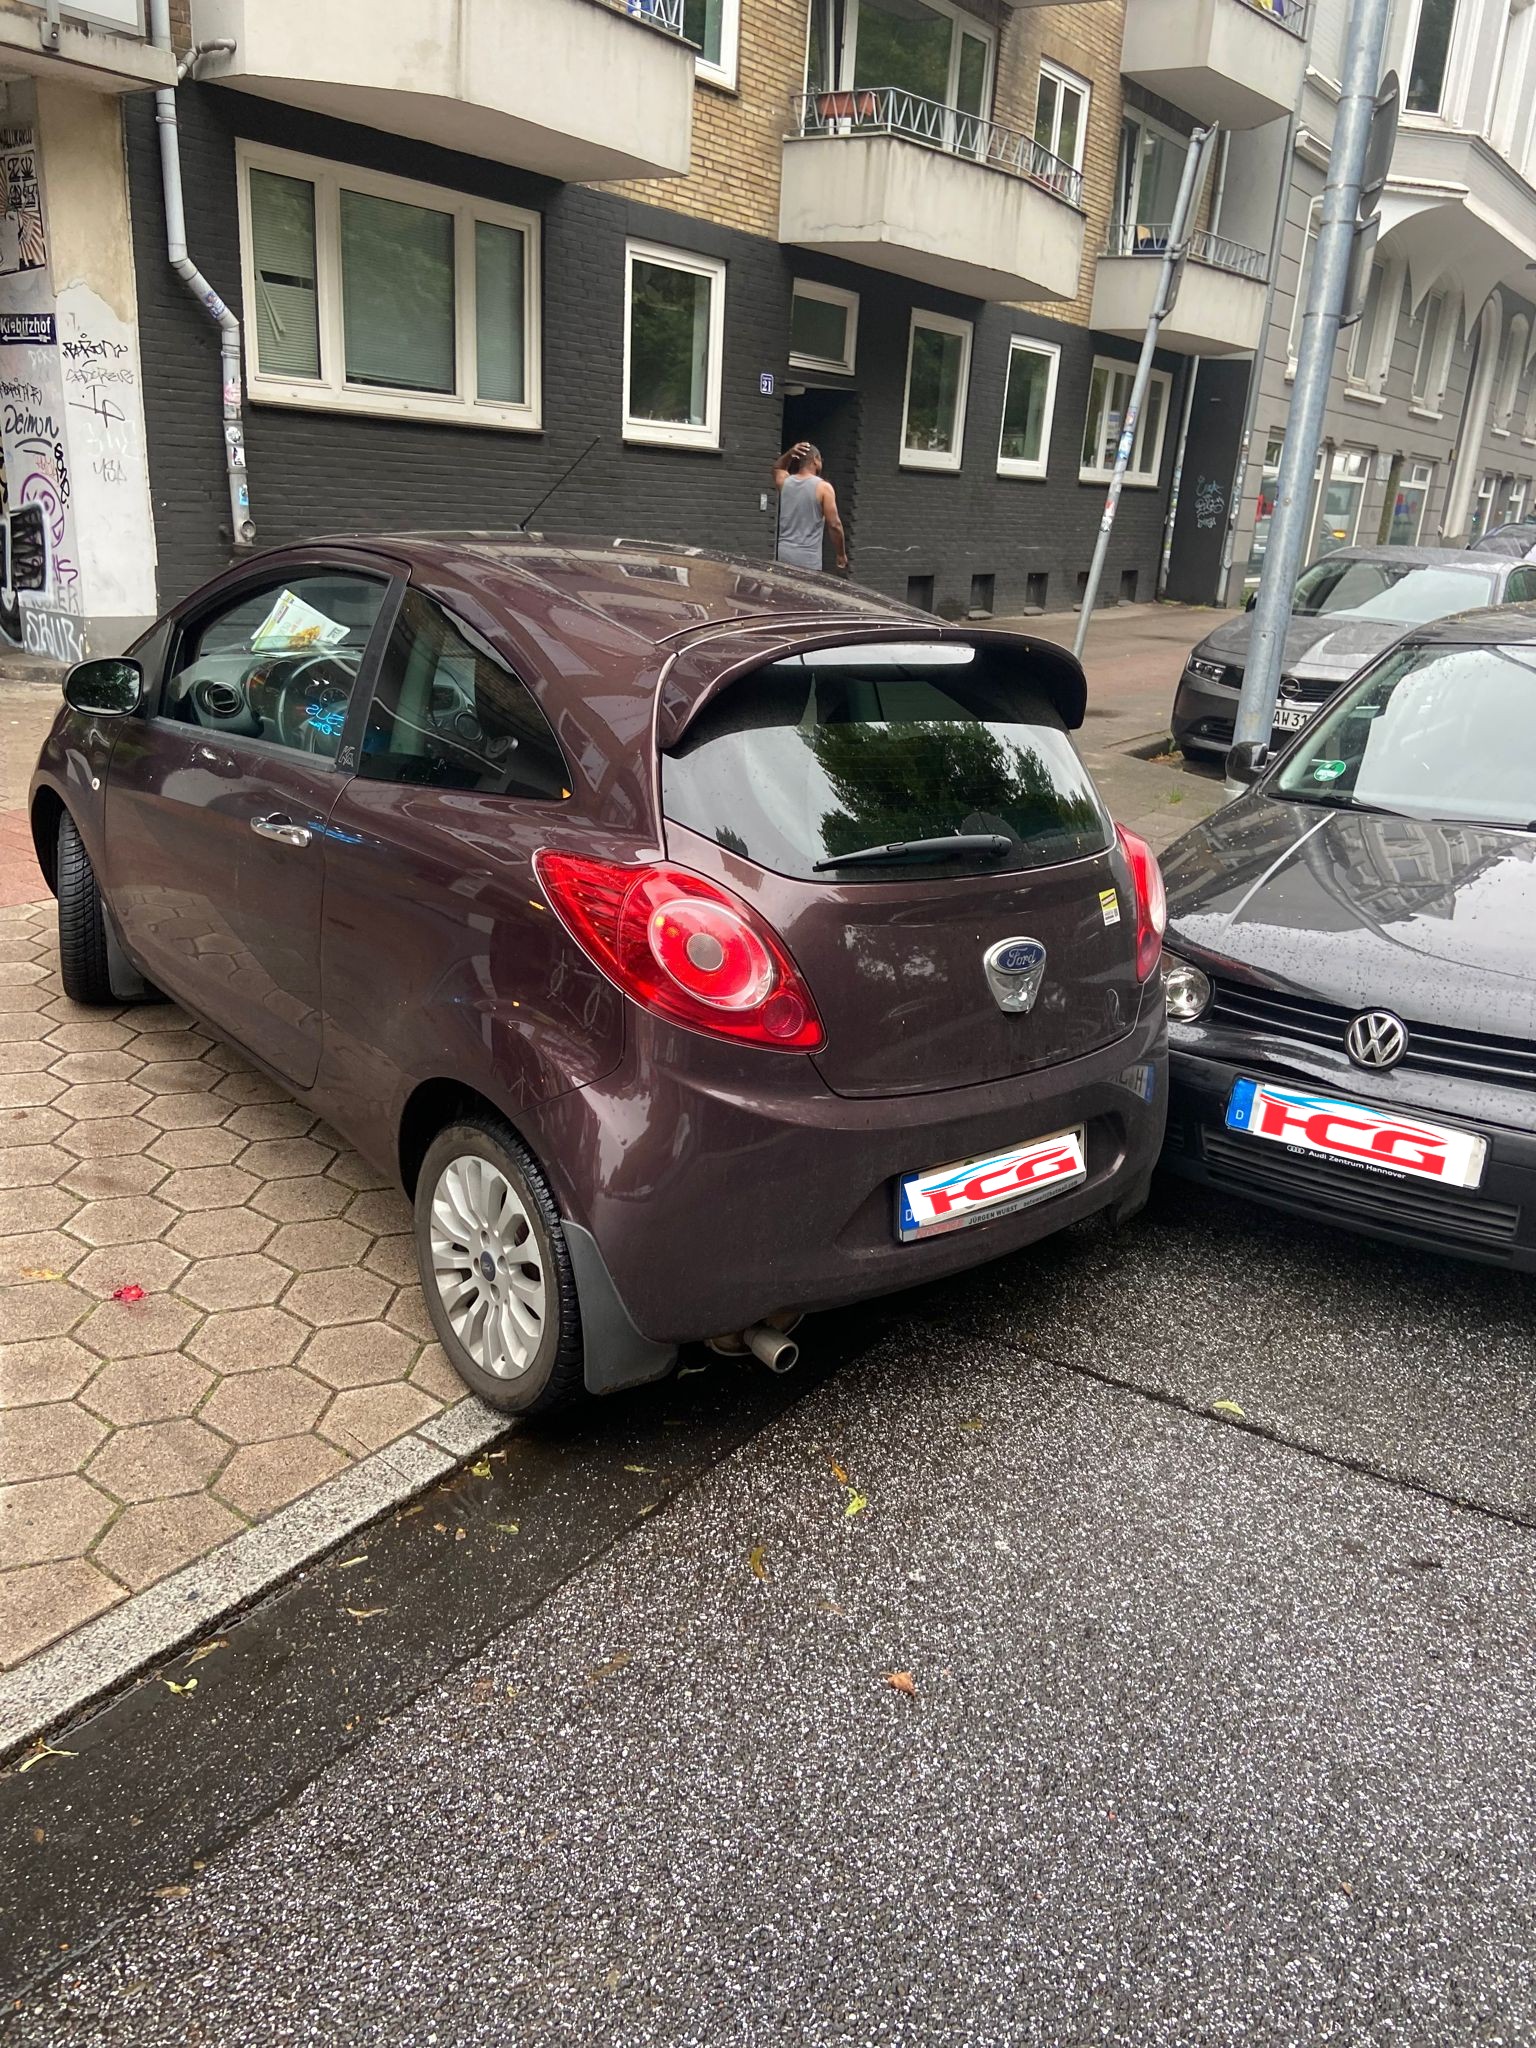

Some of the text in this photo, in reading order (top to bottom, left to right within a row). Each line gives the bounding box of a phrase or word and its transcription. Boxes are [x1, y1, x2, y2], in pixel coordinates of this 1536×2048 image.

[1, 316, 51, 334] Kiebitzhof
[762, 379, 772, 393] 21
[1006, 946, 1037, 968] Ford
[1235, 1109, 1244, 1121] D
[1308, 1150, 1407, 1179] Audi Zentrum Hannover
[968, 1211, 995, 1225] JÜRGEN
